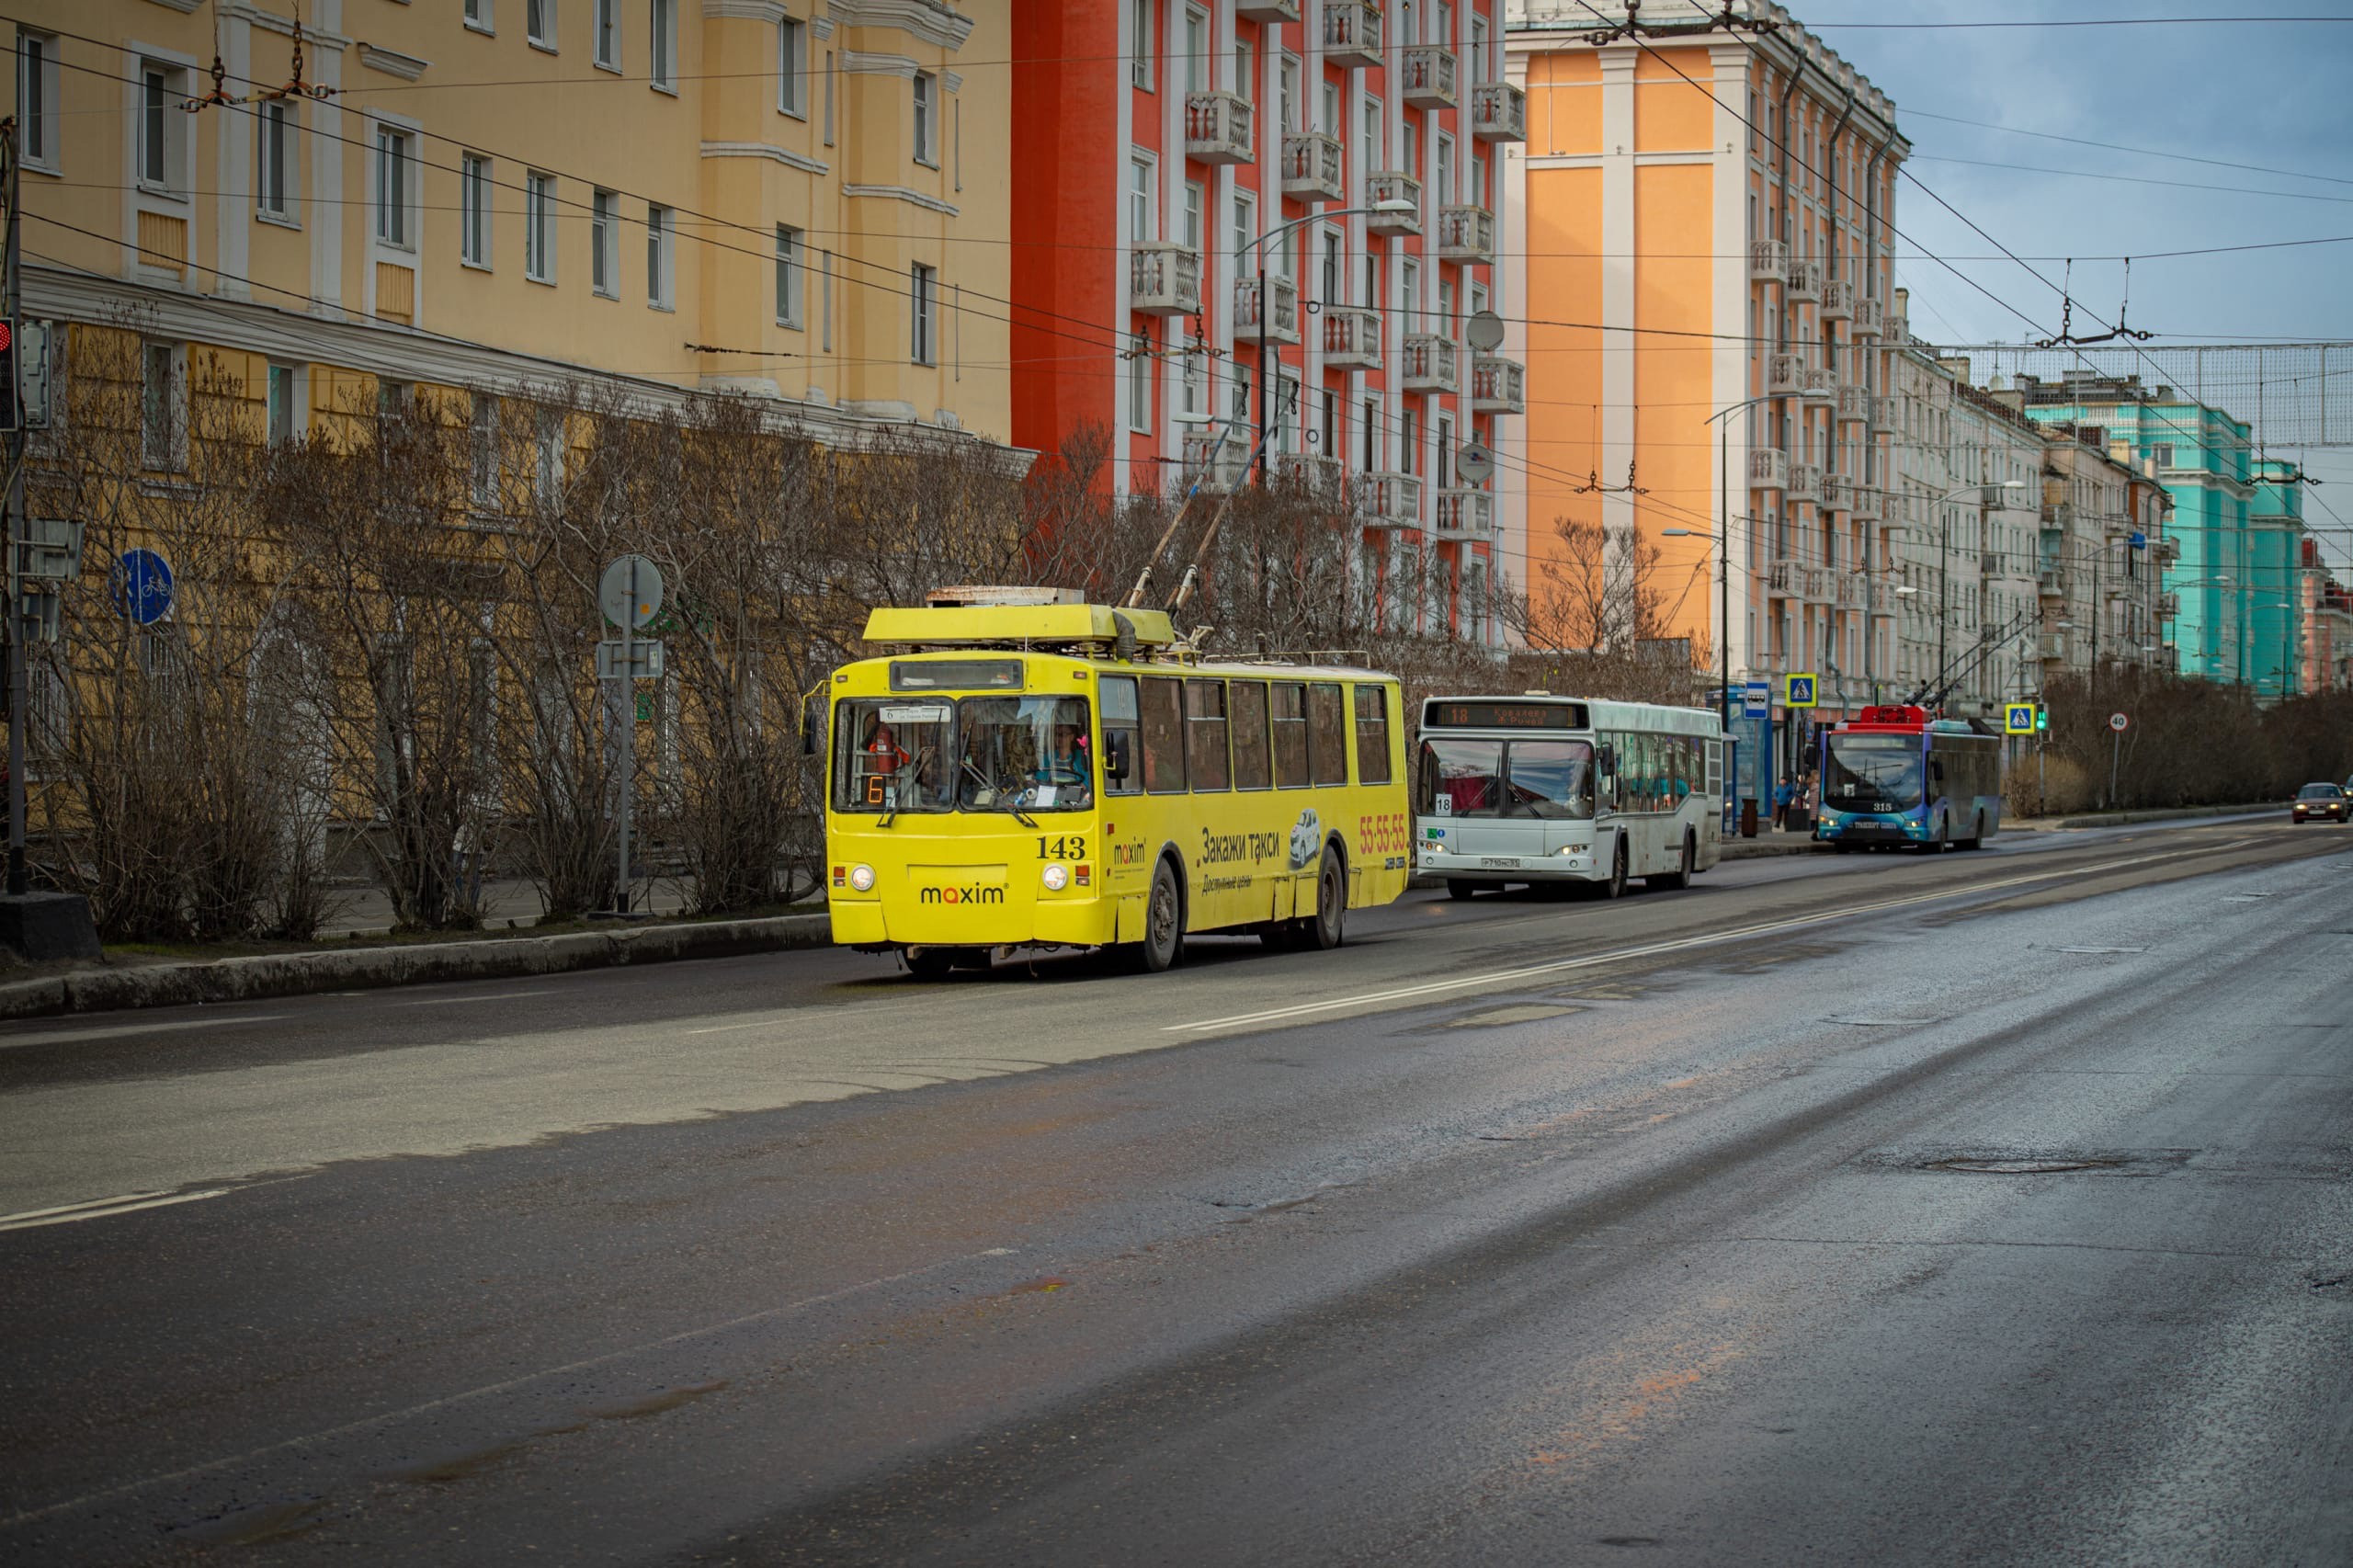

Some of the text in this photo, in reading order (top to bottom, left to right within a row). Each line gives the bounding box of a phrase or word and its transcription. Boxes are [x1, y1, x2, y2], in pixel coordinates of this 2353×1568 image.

[1451, 708, 1468, 723] 18
[2112, 717, 2125, 726] 40
[868, 776, 883, 803] 6
[1437, 798, 1450, 811] 18
[1873, 802, 1892, 812] 315
[1036, 835, 1086, 860] 143
[1202, 826, 1279, 864] Закажи такси
